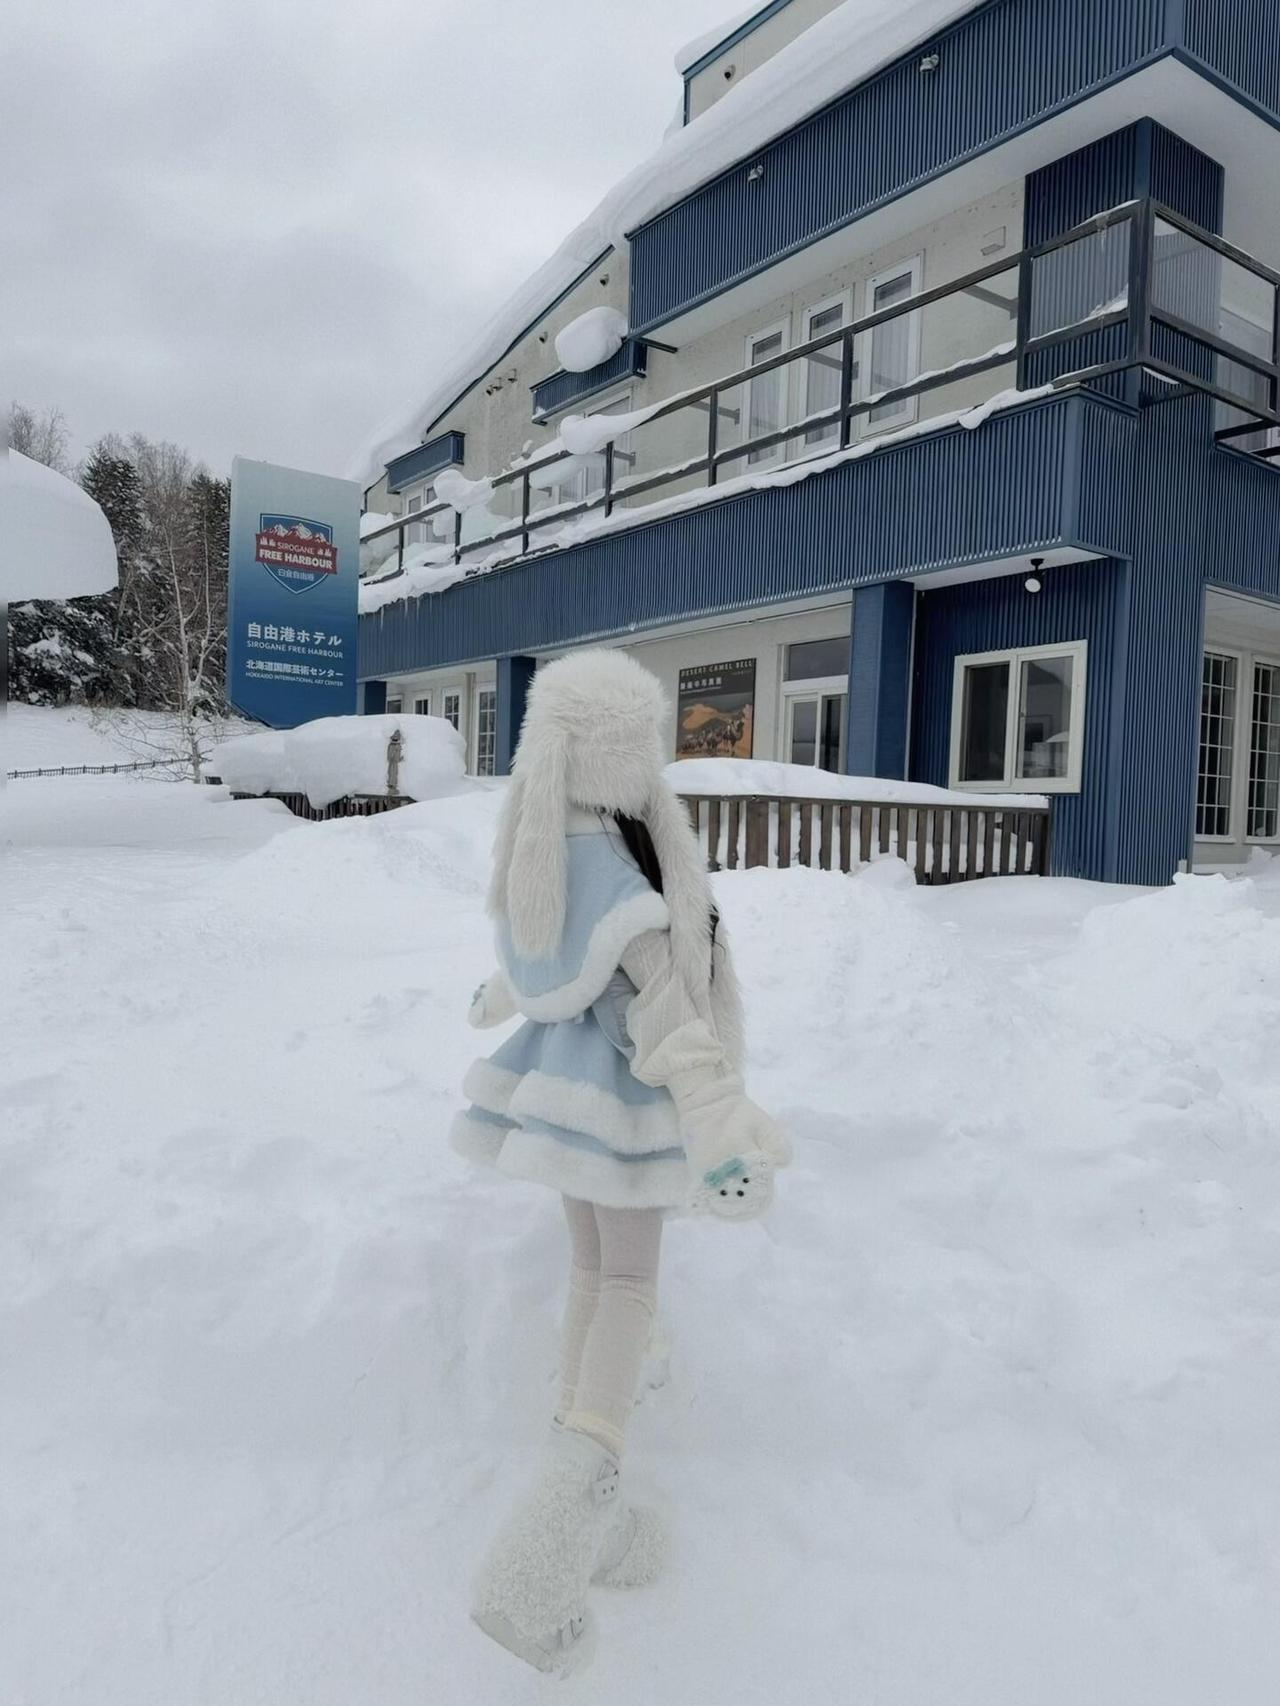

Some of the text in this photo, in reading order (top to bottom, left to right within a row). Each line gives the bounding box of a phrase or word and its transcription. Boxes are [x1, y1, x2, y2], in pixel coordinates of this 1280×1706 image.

[277, 542, 315, 554] SIROGANE
[259, 549, 332, 569] FREE HARBOUR
[248, 622, 342, 646] 自由港ホテル
[247, 640, 343, 658] SIROGANE FREE HARBOUR
